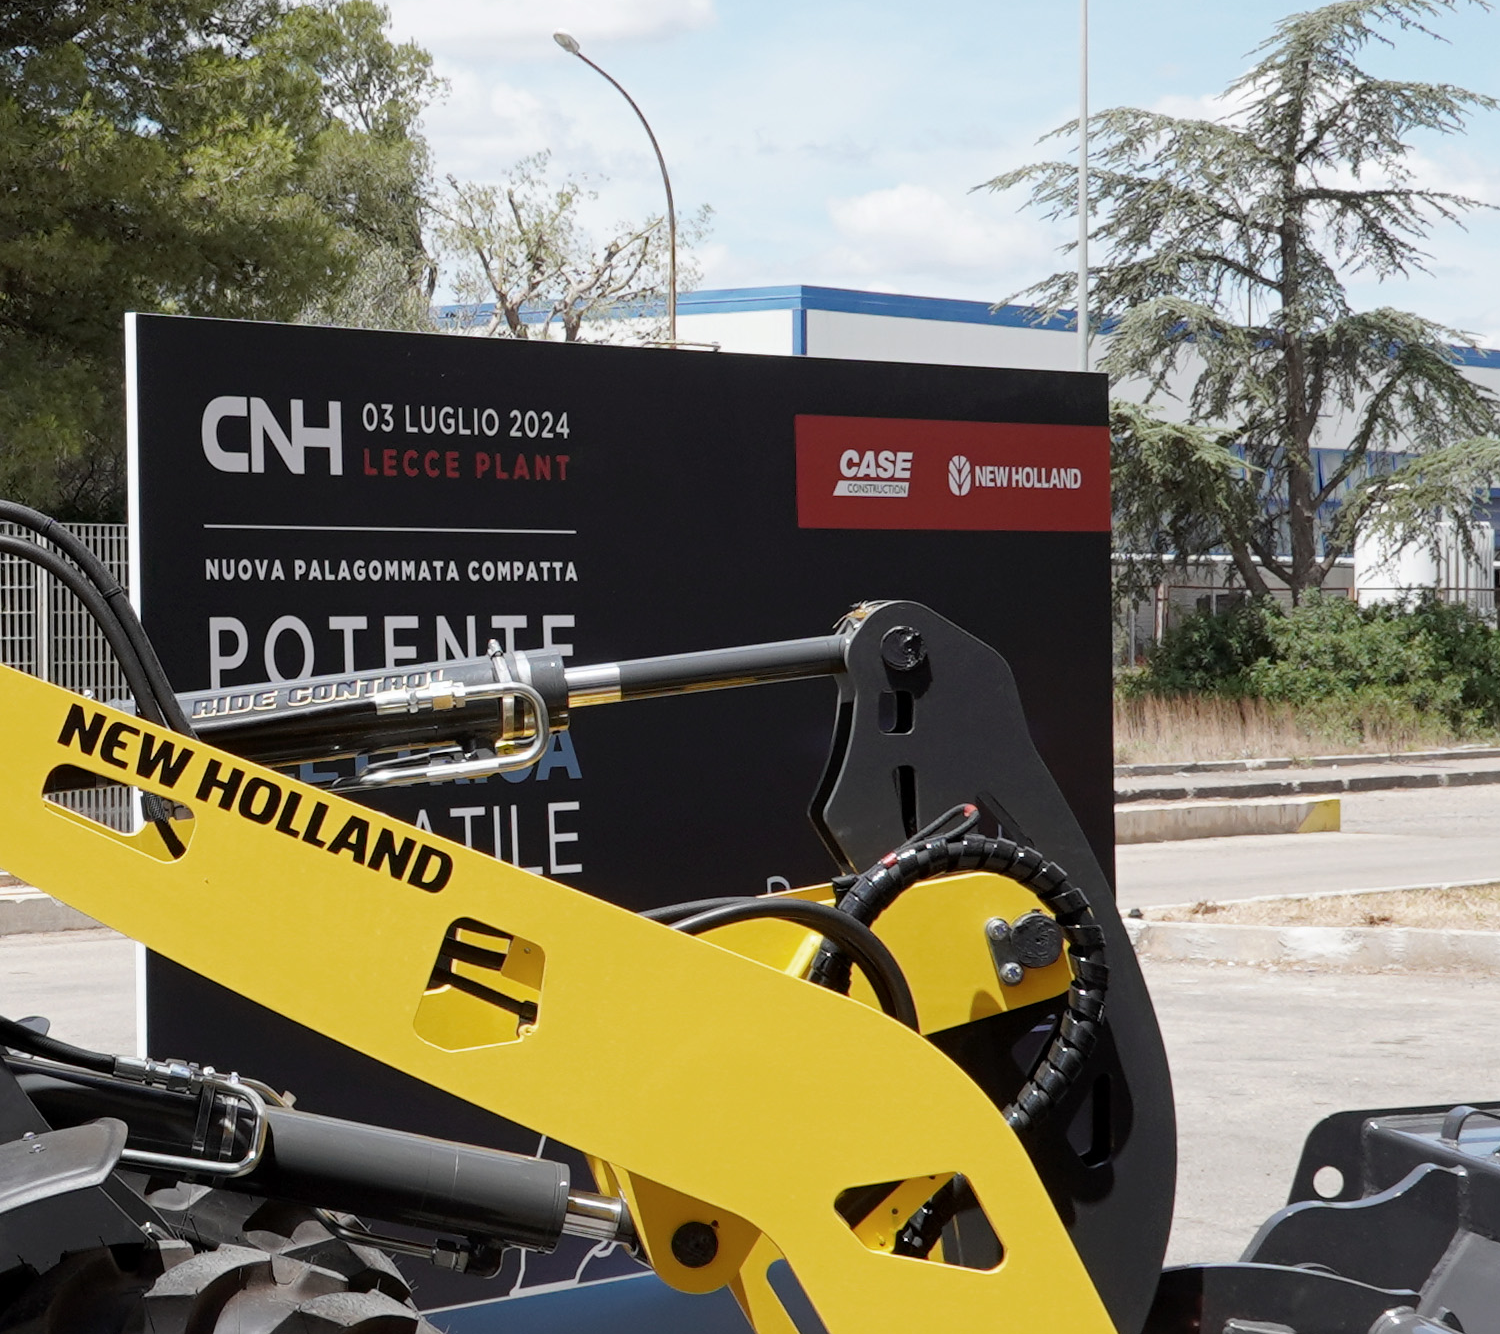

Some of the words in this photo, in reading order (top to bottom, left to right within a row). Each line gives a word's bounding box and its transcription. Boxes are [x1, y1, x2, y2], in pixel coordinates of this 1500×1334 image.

[201, 395, 343, 475] CNH
[362, 402, 395, 432] 03
[404, 405, 500, 437] LUGLIO
[509, 410, 570, 440] 2024
[363, 448, 461, 478] LECCE
[476, 452, 571, 481] PLANT
[839, 449, 913, 479] CASE
[974, 465, 1009, 487] NEW
[1011, 466, 1082, 489] HOLLAND
[847, 483, 907, 495] CONSTRUCTION
[205, 558, 285, 581] NUOVA
[294, 559, 460, 582] PALAGOMMATA
[467, 561, 579, 583] COMPATTA
[209, 615, 576, 691] POTENTE
[192, 690, 279, 719] RIDE
[57, 703, 194, 788] NEW
[195, 757, 454, 894] HOLLAND
